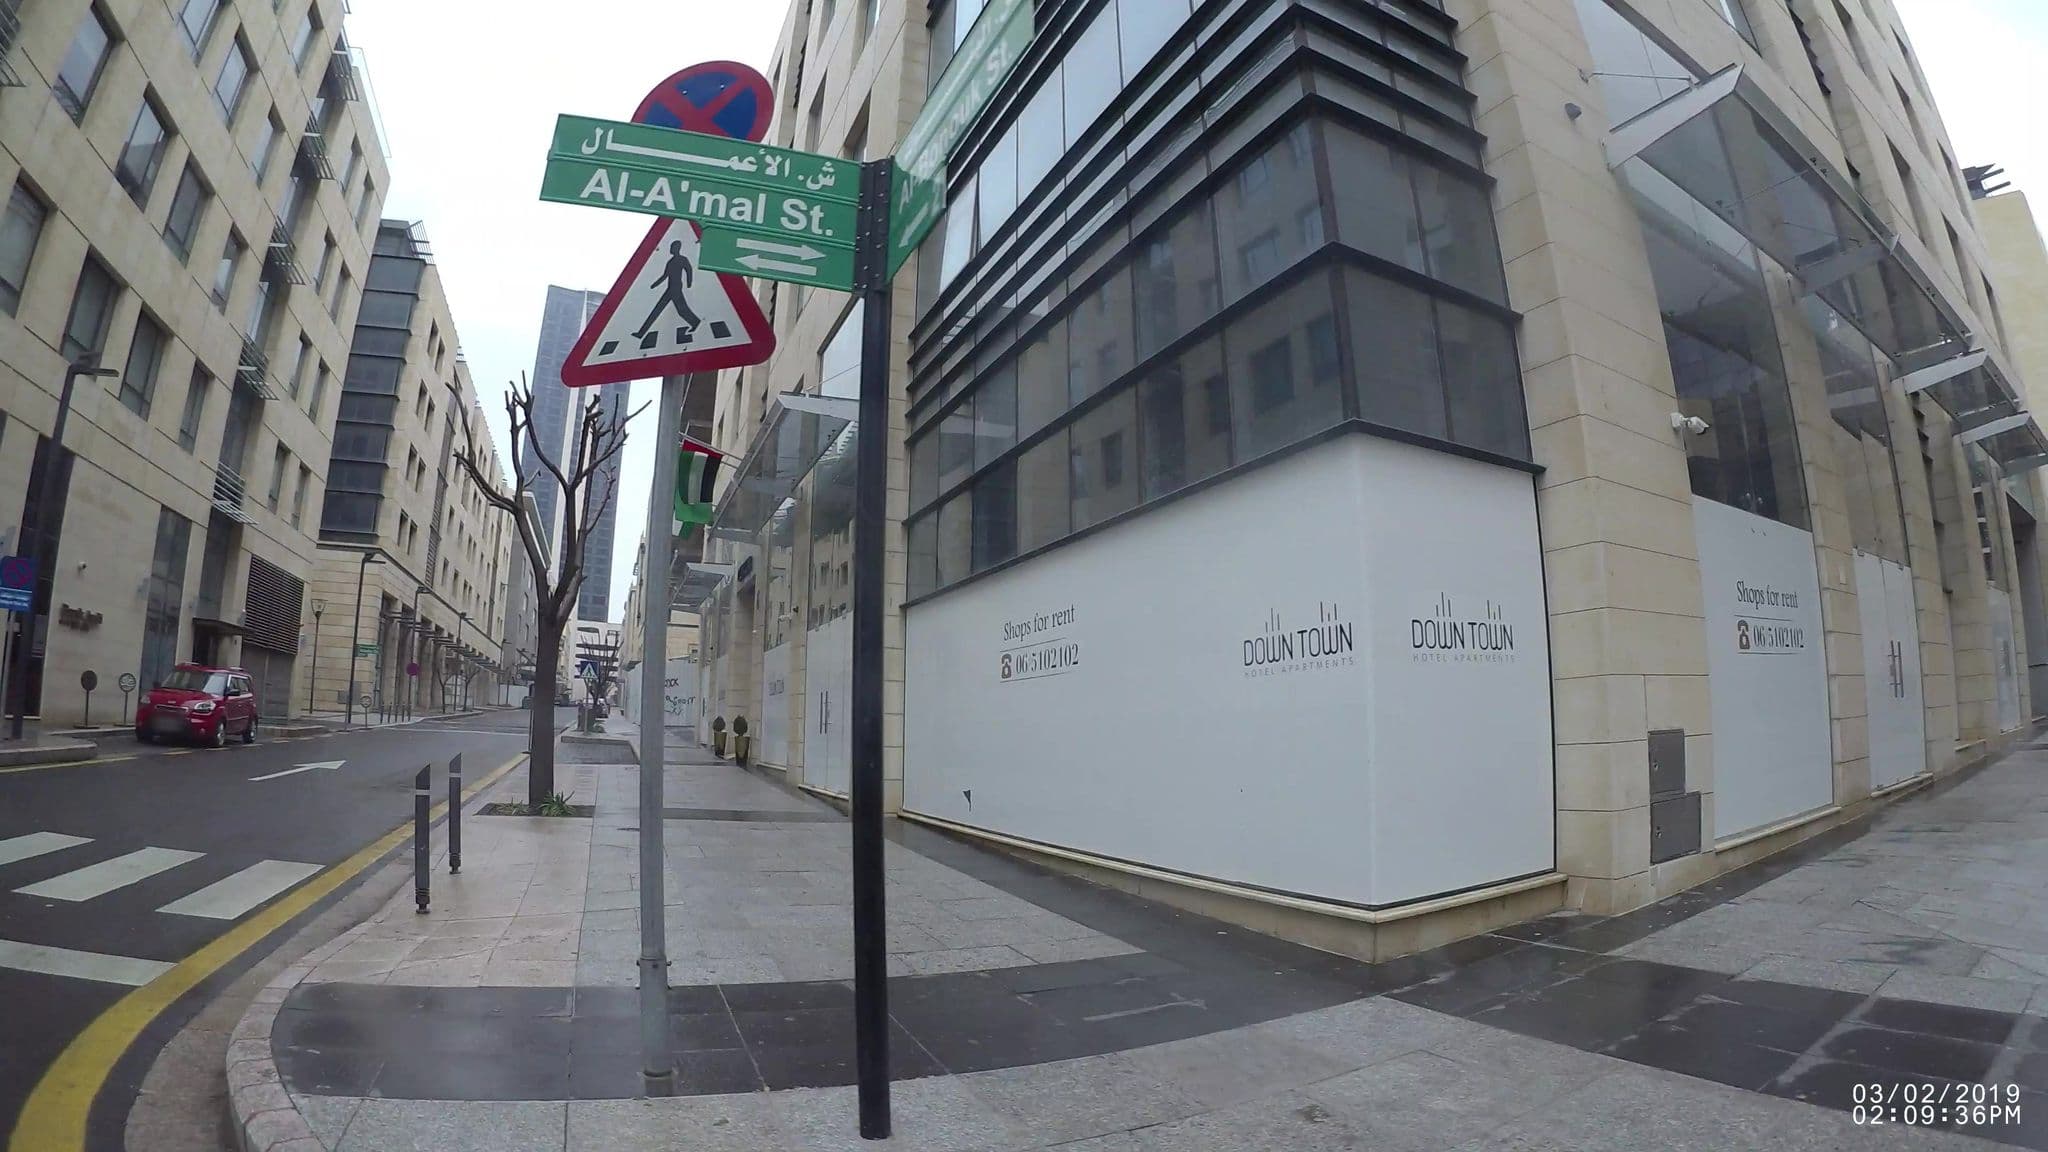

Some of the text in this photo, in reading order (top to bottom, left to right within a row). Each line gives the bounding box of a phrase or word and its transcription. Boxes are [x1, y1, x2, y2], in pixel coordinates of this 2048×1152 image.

[580, 168, 834, 236] Al-A'mal St.
[1736, 580, 1799, 610] Shops for rent
[1004, 604, 1076, 642] Shops for rent
[1412, 619, 1514, 651] DOWN TOWN
[1243, 622, 1353, 667] DOWN TOWN
